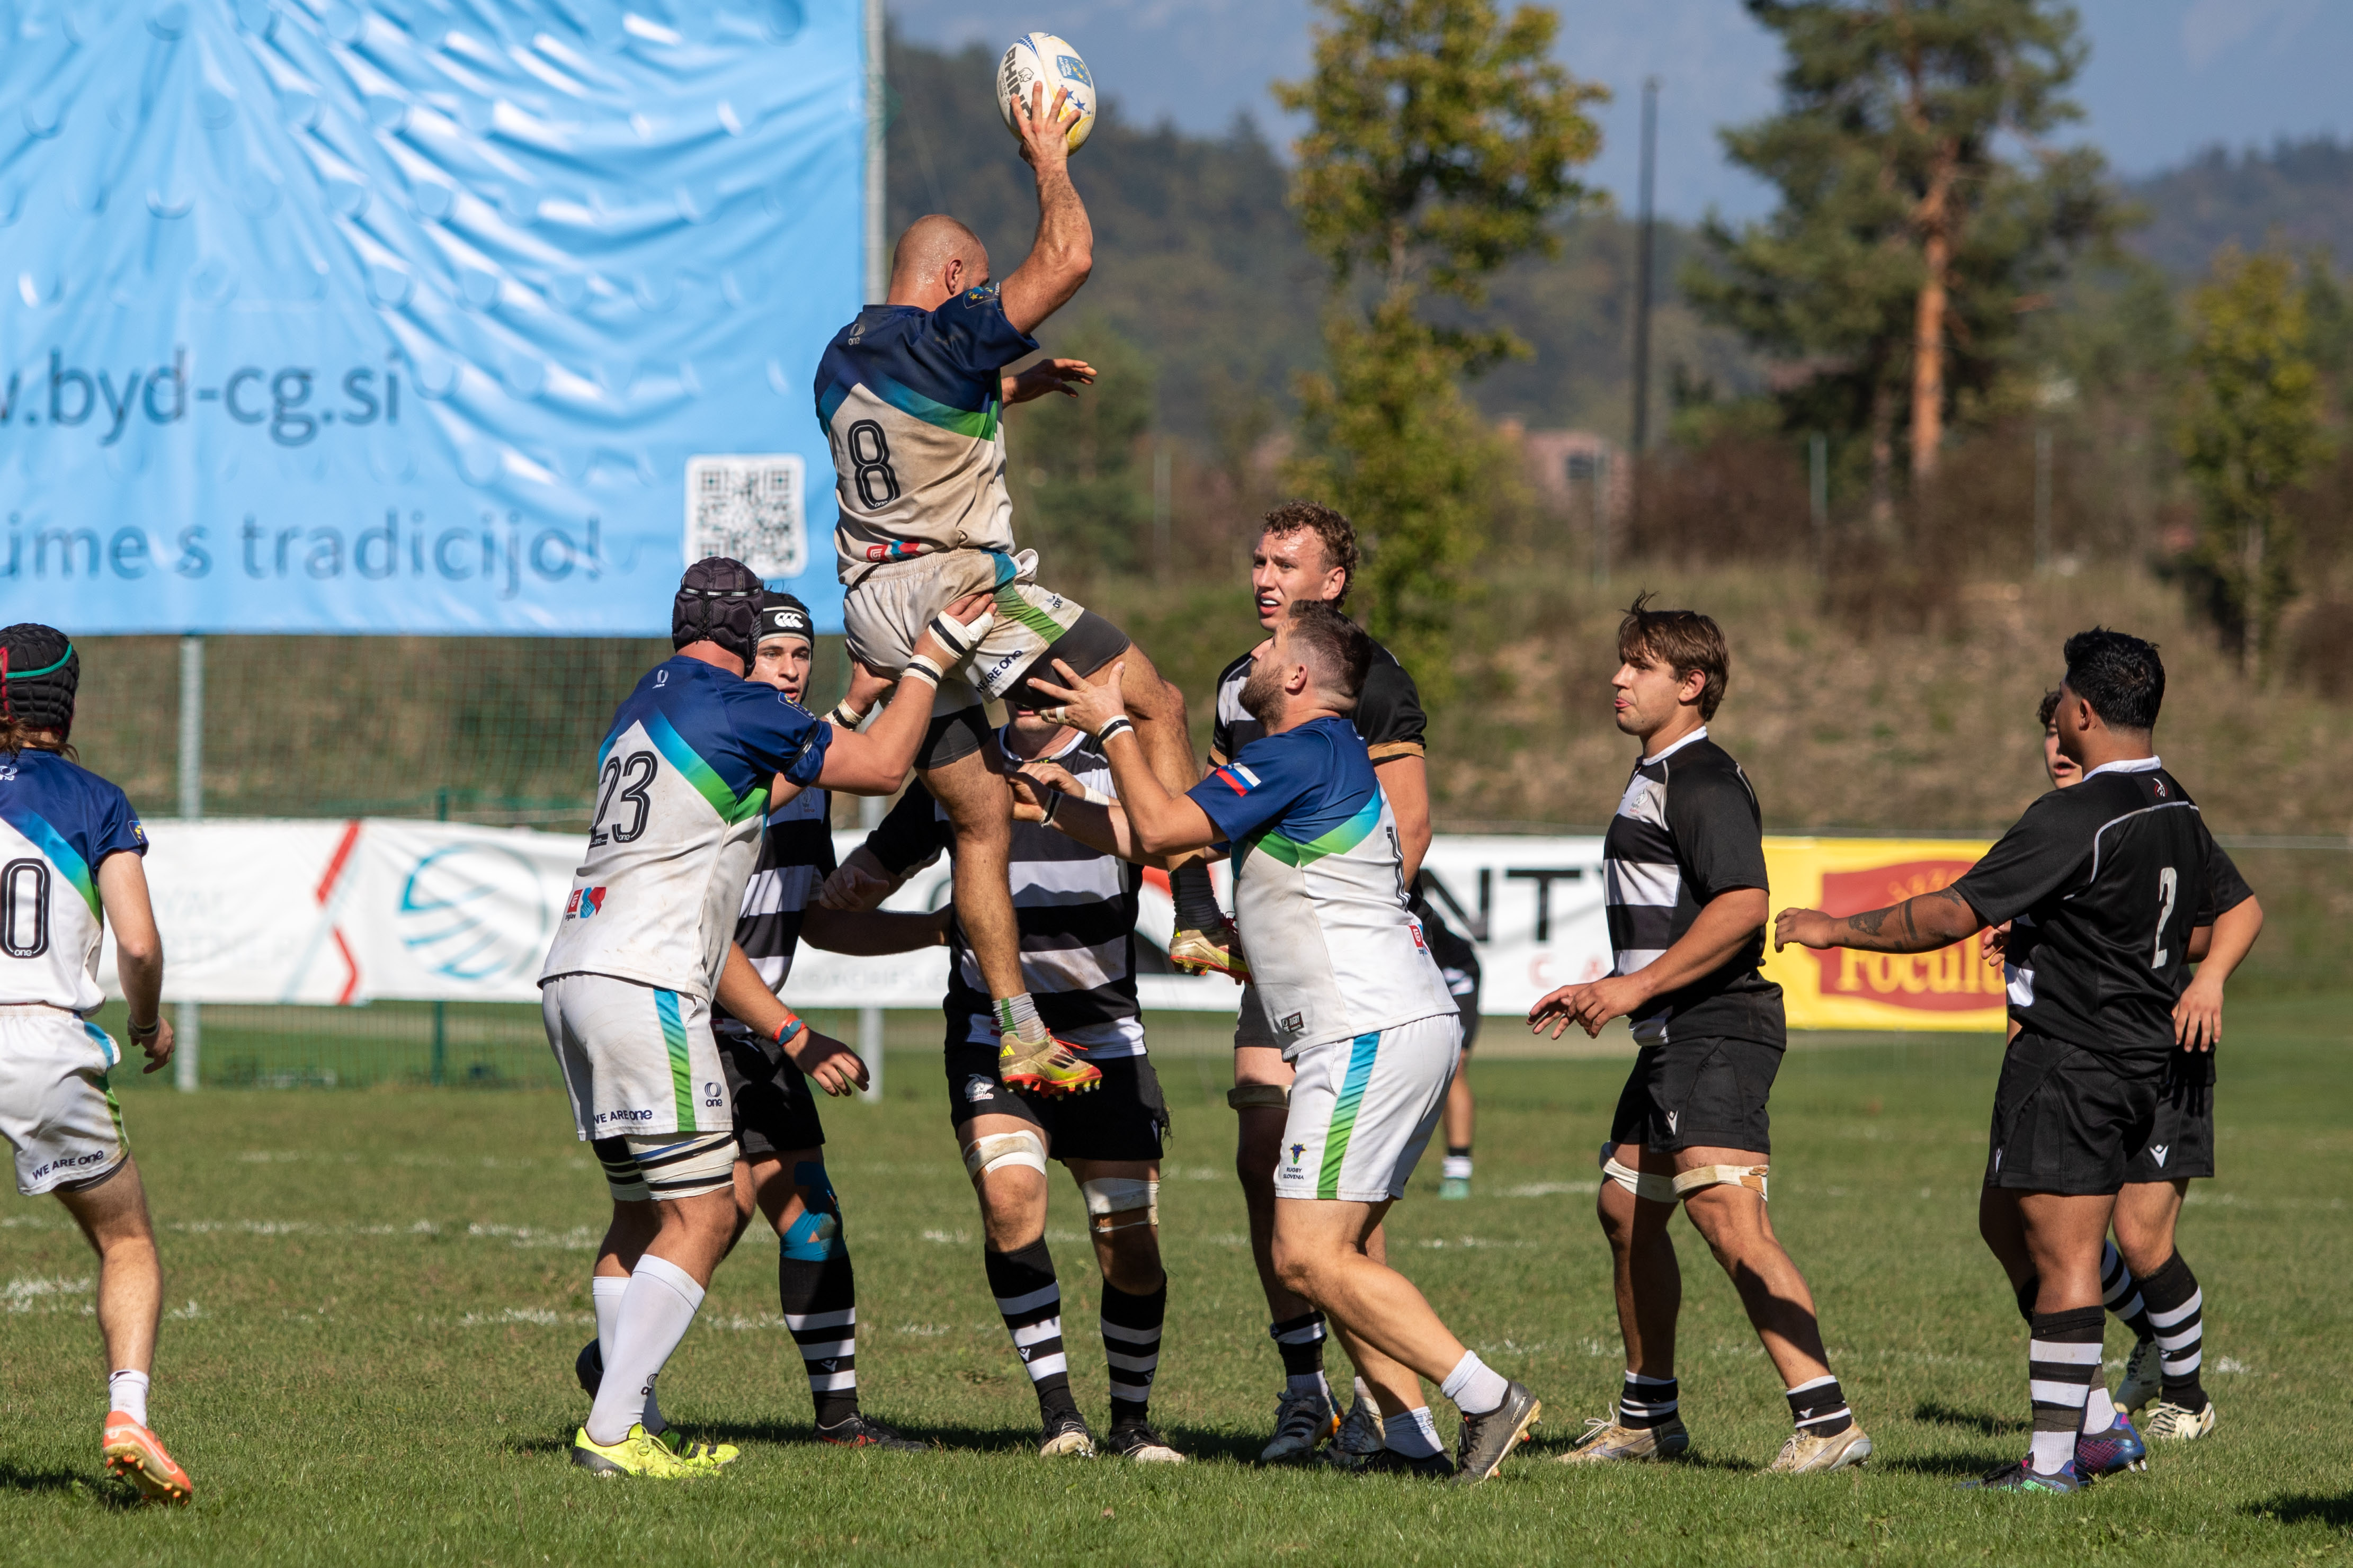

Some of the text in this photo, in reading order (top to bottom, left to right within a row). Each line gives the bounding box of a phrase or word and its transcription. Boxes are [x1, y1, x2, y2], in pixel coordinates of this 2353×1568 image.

[848, 337, 860, 346] one
[847, 418, 901, 510] 8
[176, 524, 213, 581] s
[240, 507, 601, 601] tradicijo!
[984, 667, 1002, 685] ARE
[999, 650, 1023, 669] one
[588, 750, 658, 850] 23
[2151, 867, 2177, 969] 2
[610, 1110, 629, 1122] ARE
[629, 1109, 653, 1121] one
[706, 1099, 723, 1107] one
[32, 1150, 104, 1181] WE ARE one
[1510, 1396, 1527, 1424] KOOGA
